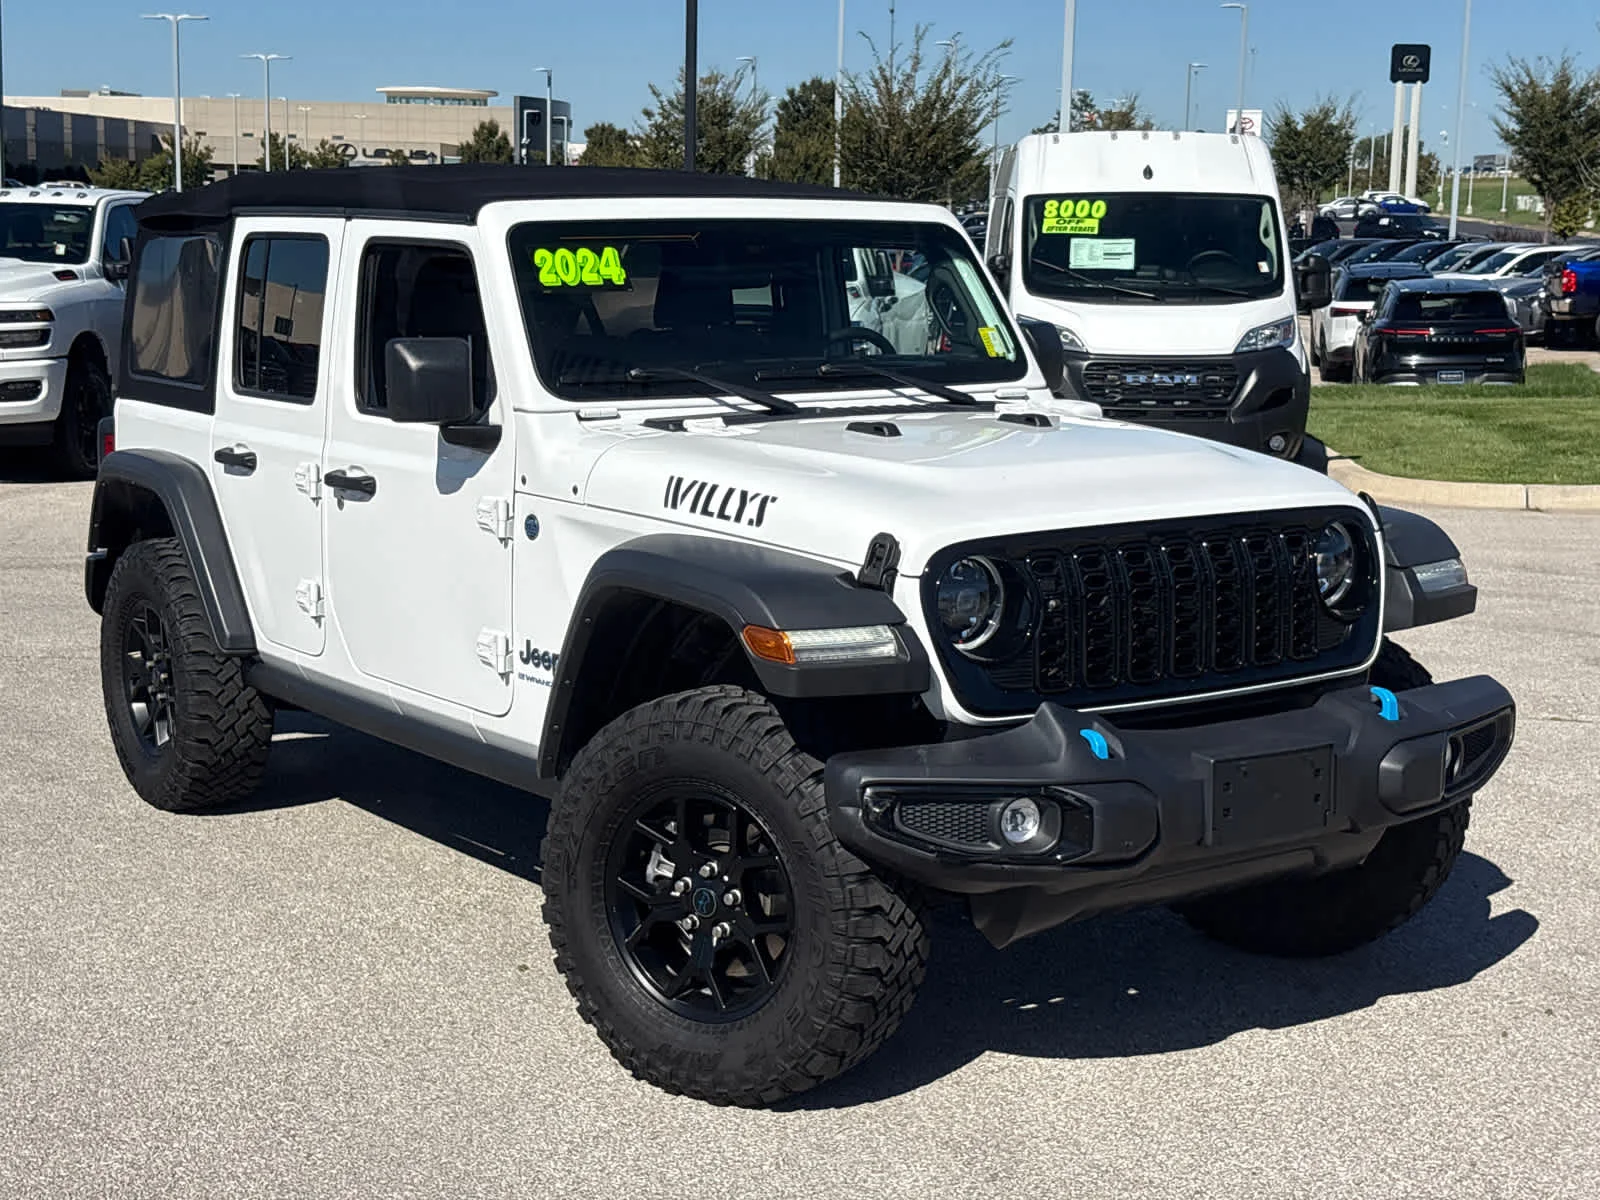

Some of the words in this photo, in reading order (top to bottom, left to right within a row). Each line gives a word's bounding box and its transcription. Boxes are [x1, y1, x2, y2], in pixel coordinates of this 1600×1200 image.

[1044, 199, 1107, 219] 8000
[534, 247, 626, 286] 2024
[1121, 373, 1200, 386] RAM
[663, 475, 779, 527] WILLYS
